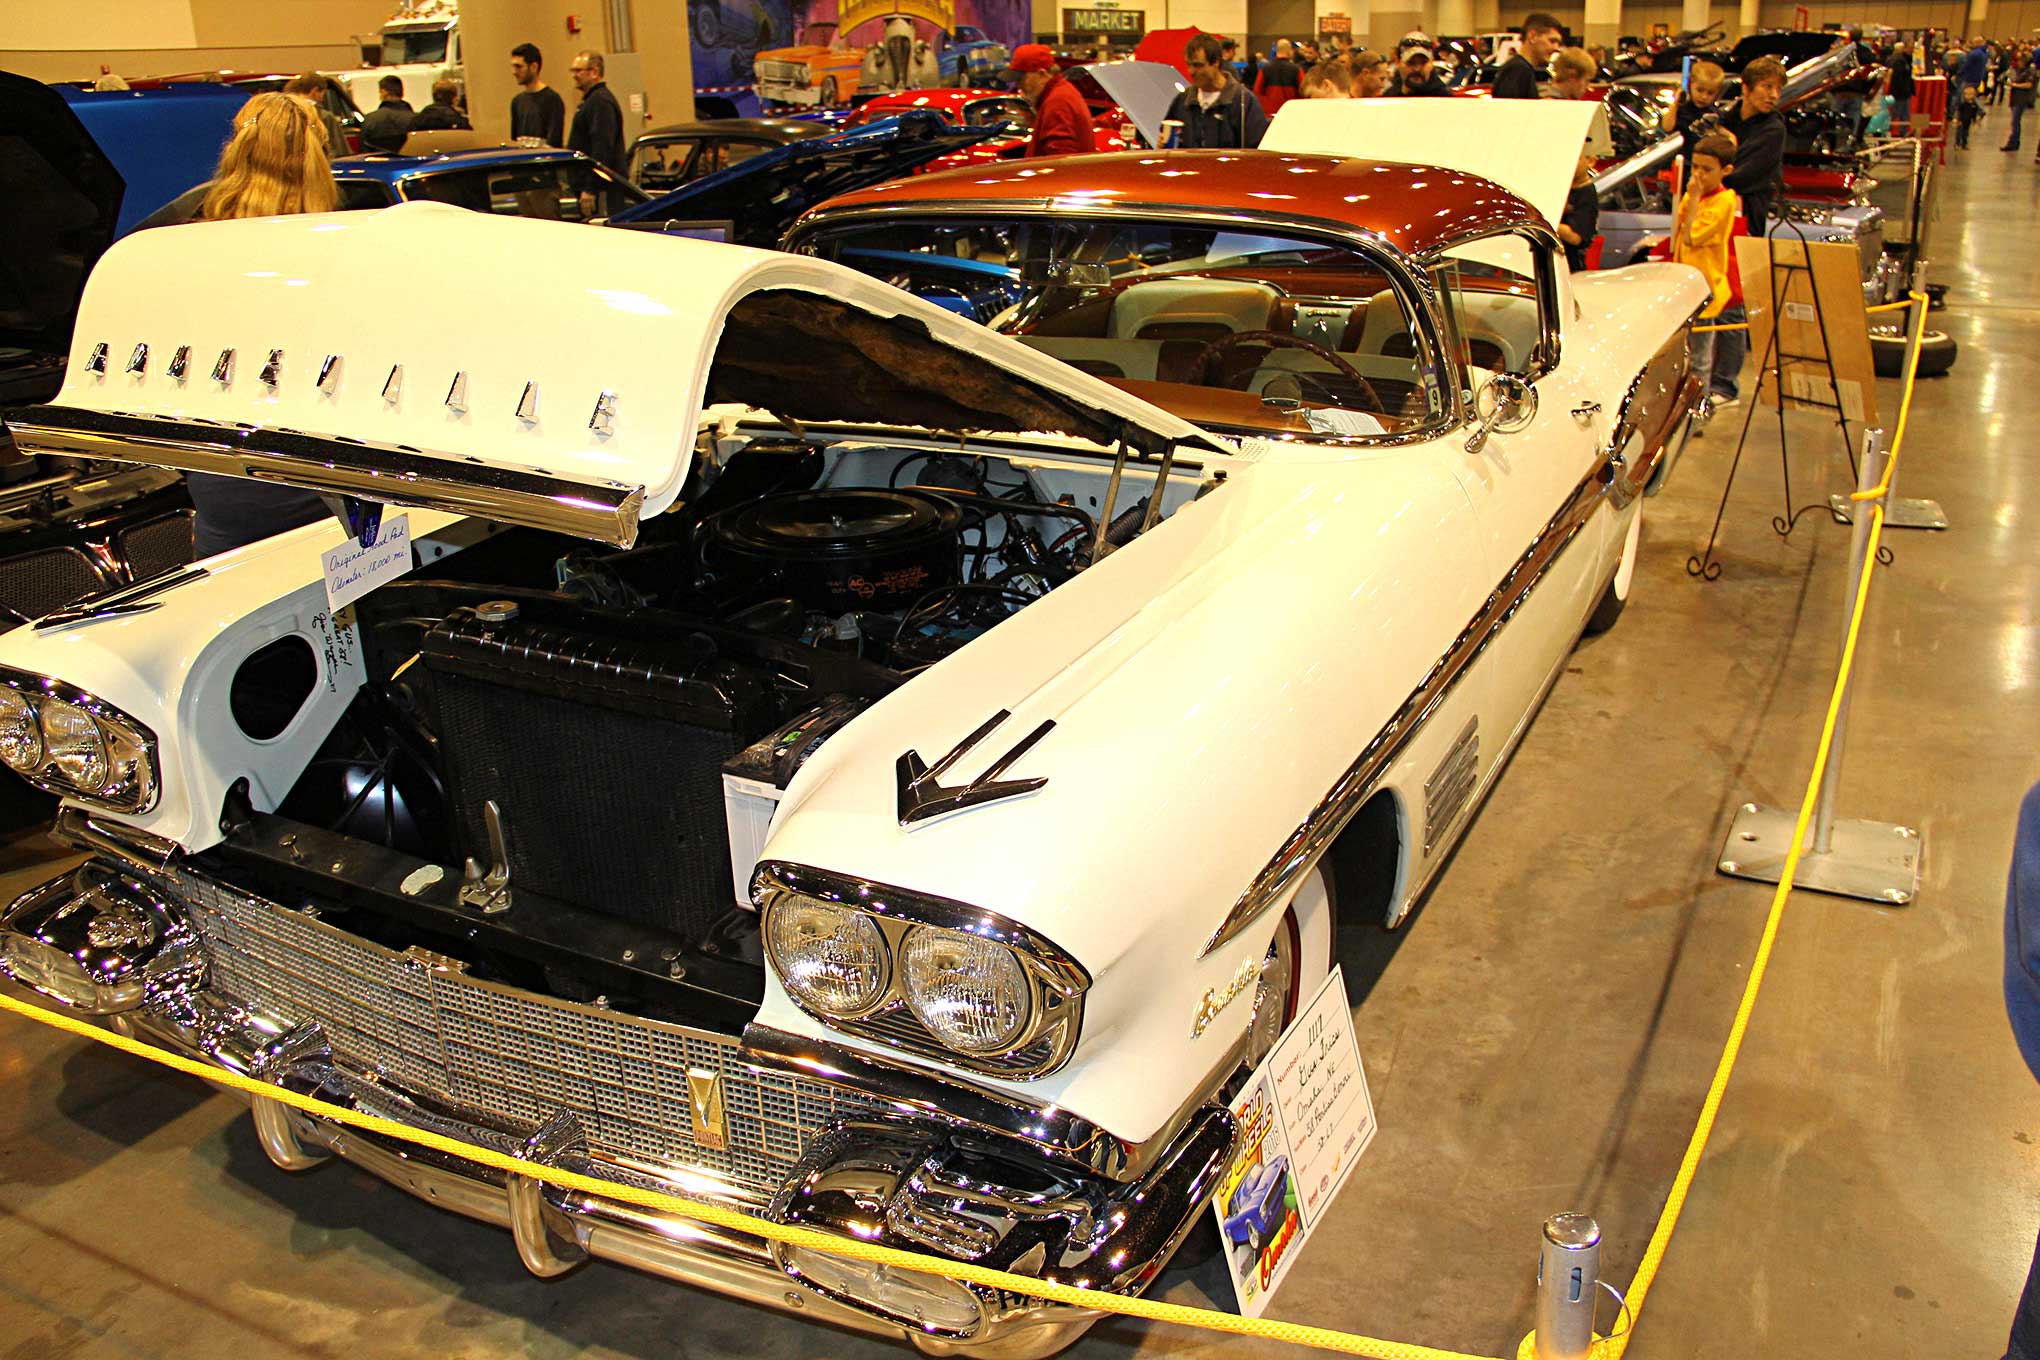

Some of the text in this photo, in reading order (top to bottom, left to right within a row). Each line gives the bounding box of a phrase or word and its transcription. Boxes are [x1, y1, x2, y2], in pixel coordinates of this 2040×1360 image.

[1073, 11, 1139, 31] MARKET
[1308, 1012, 1323, 1049] 1117
[1238, 1087, 1264, 1137] ORLD
[1234, 1101, 1274, 1176] WHEELS
